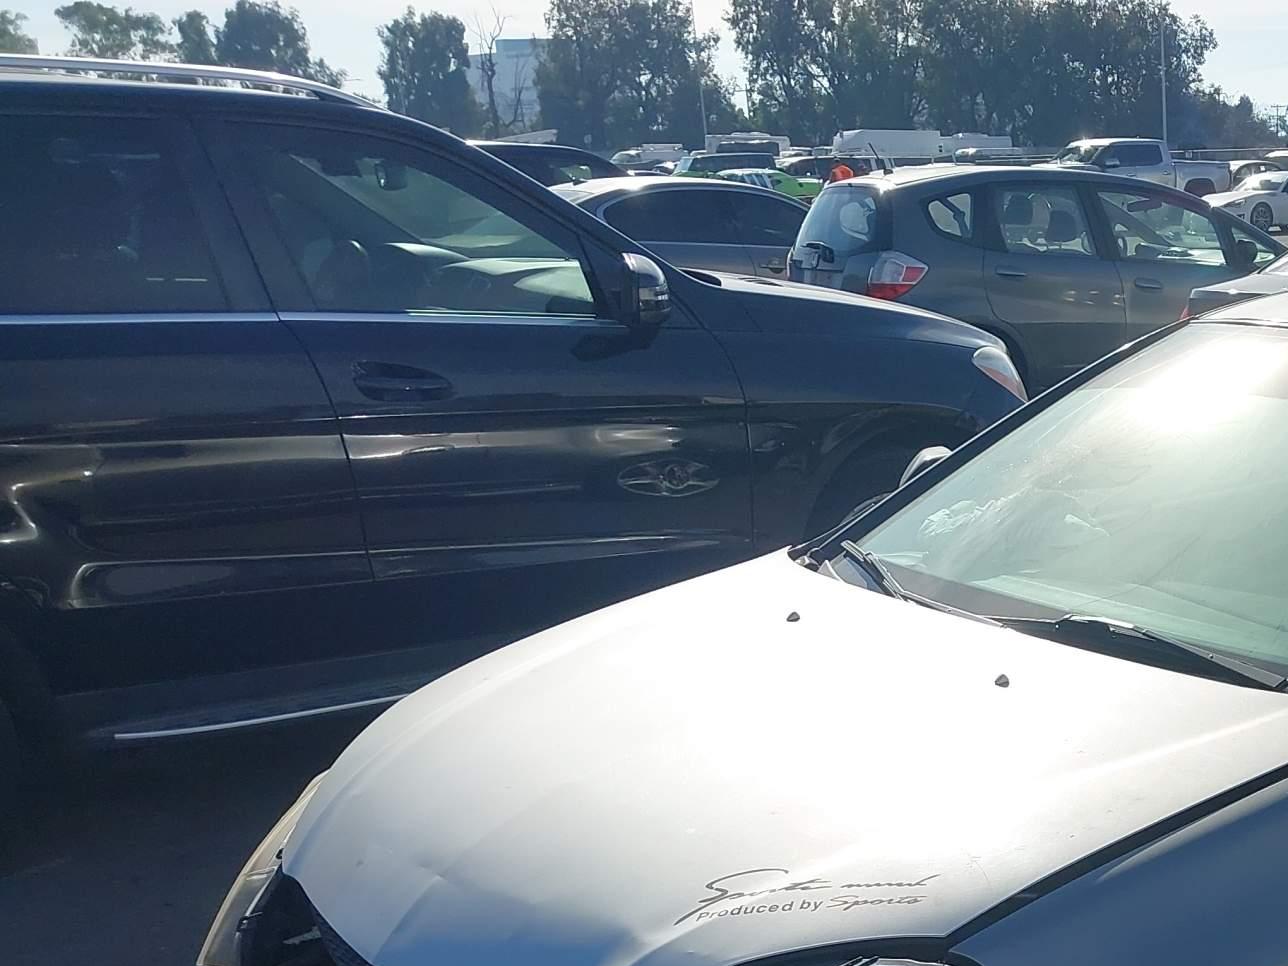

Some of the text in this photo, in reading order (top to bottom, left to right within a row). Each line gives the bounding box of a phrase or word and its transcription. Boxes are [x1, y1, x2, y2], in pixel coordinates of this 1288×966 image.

[696, 895, 928, 922] Produced by Sports
